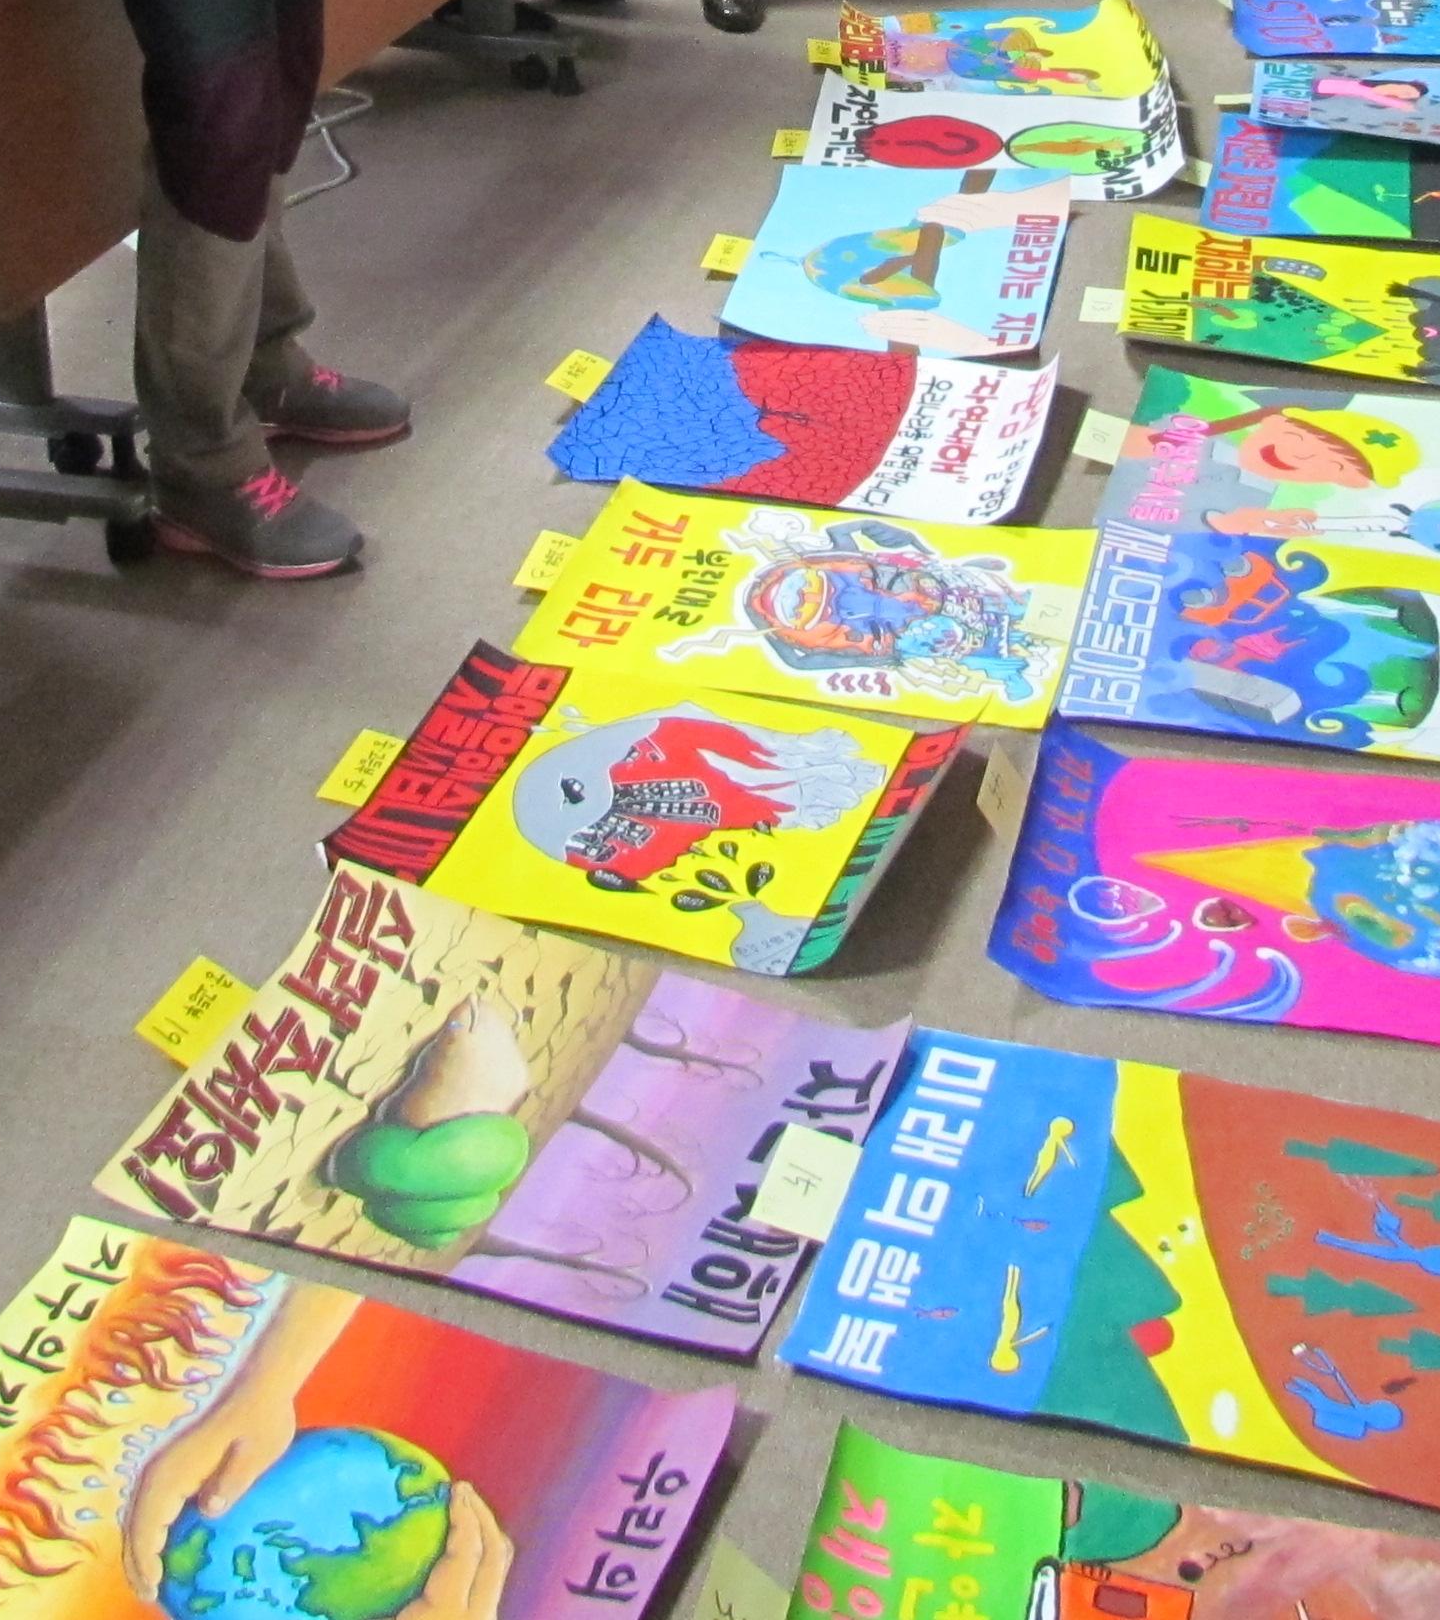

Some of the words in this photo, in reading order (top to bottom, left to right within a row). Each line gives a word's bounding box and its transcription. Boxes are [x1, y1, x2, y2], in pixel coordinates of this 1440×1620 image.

[1135, 246, 1193, 276] 늘
[1192, 230, 1253, 300] 재해는
[988, 312, 1037, 348] 지구
[897, 376, 954, 440] 우리나라를
[610, 511, 691, 569] 거두
[558, 582, 655, 651] 리라
[123, 868, 417, 1223] 살려주세요!
[660, 1054, 890, 1327] 자재해
[865, 1048, 998, 1238] 미래의
[2, 1233, 130, 1377] 지구의
[807, 1249, 910, 1376] 행복
[565, 1448, 693, 1606] 우리의
